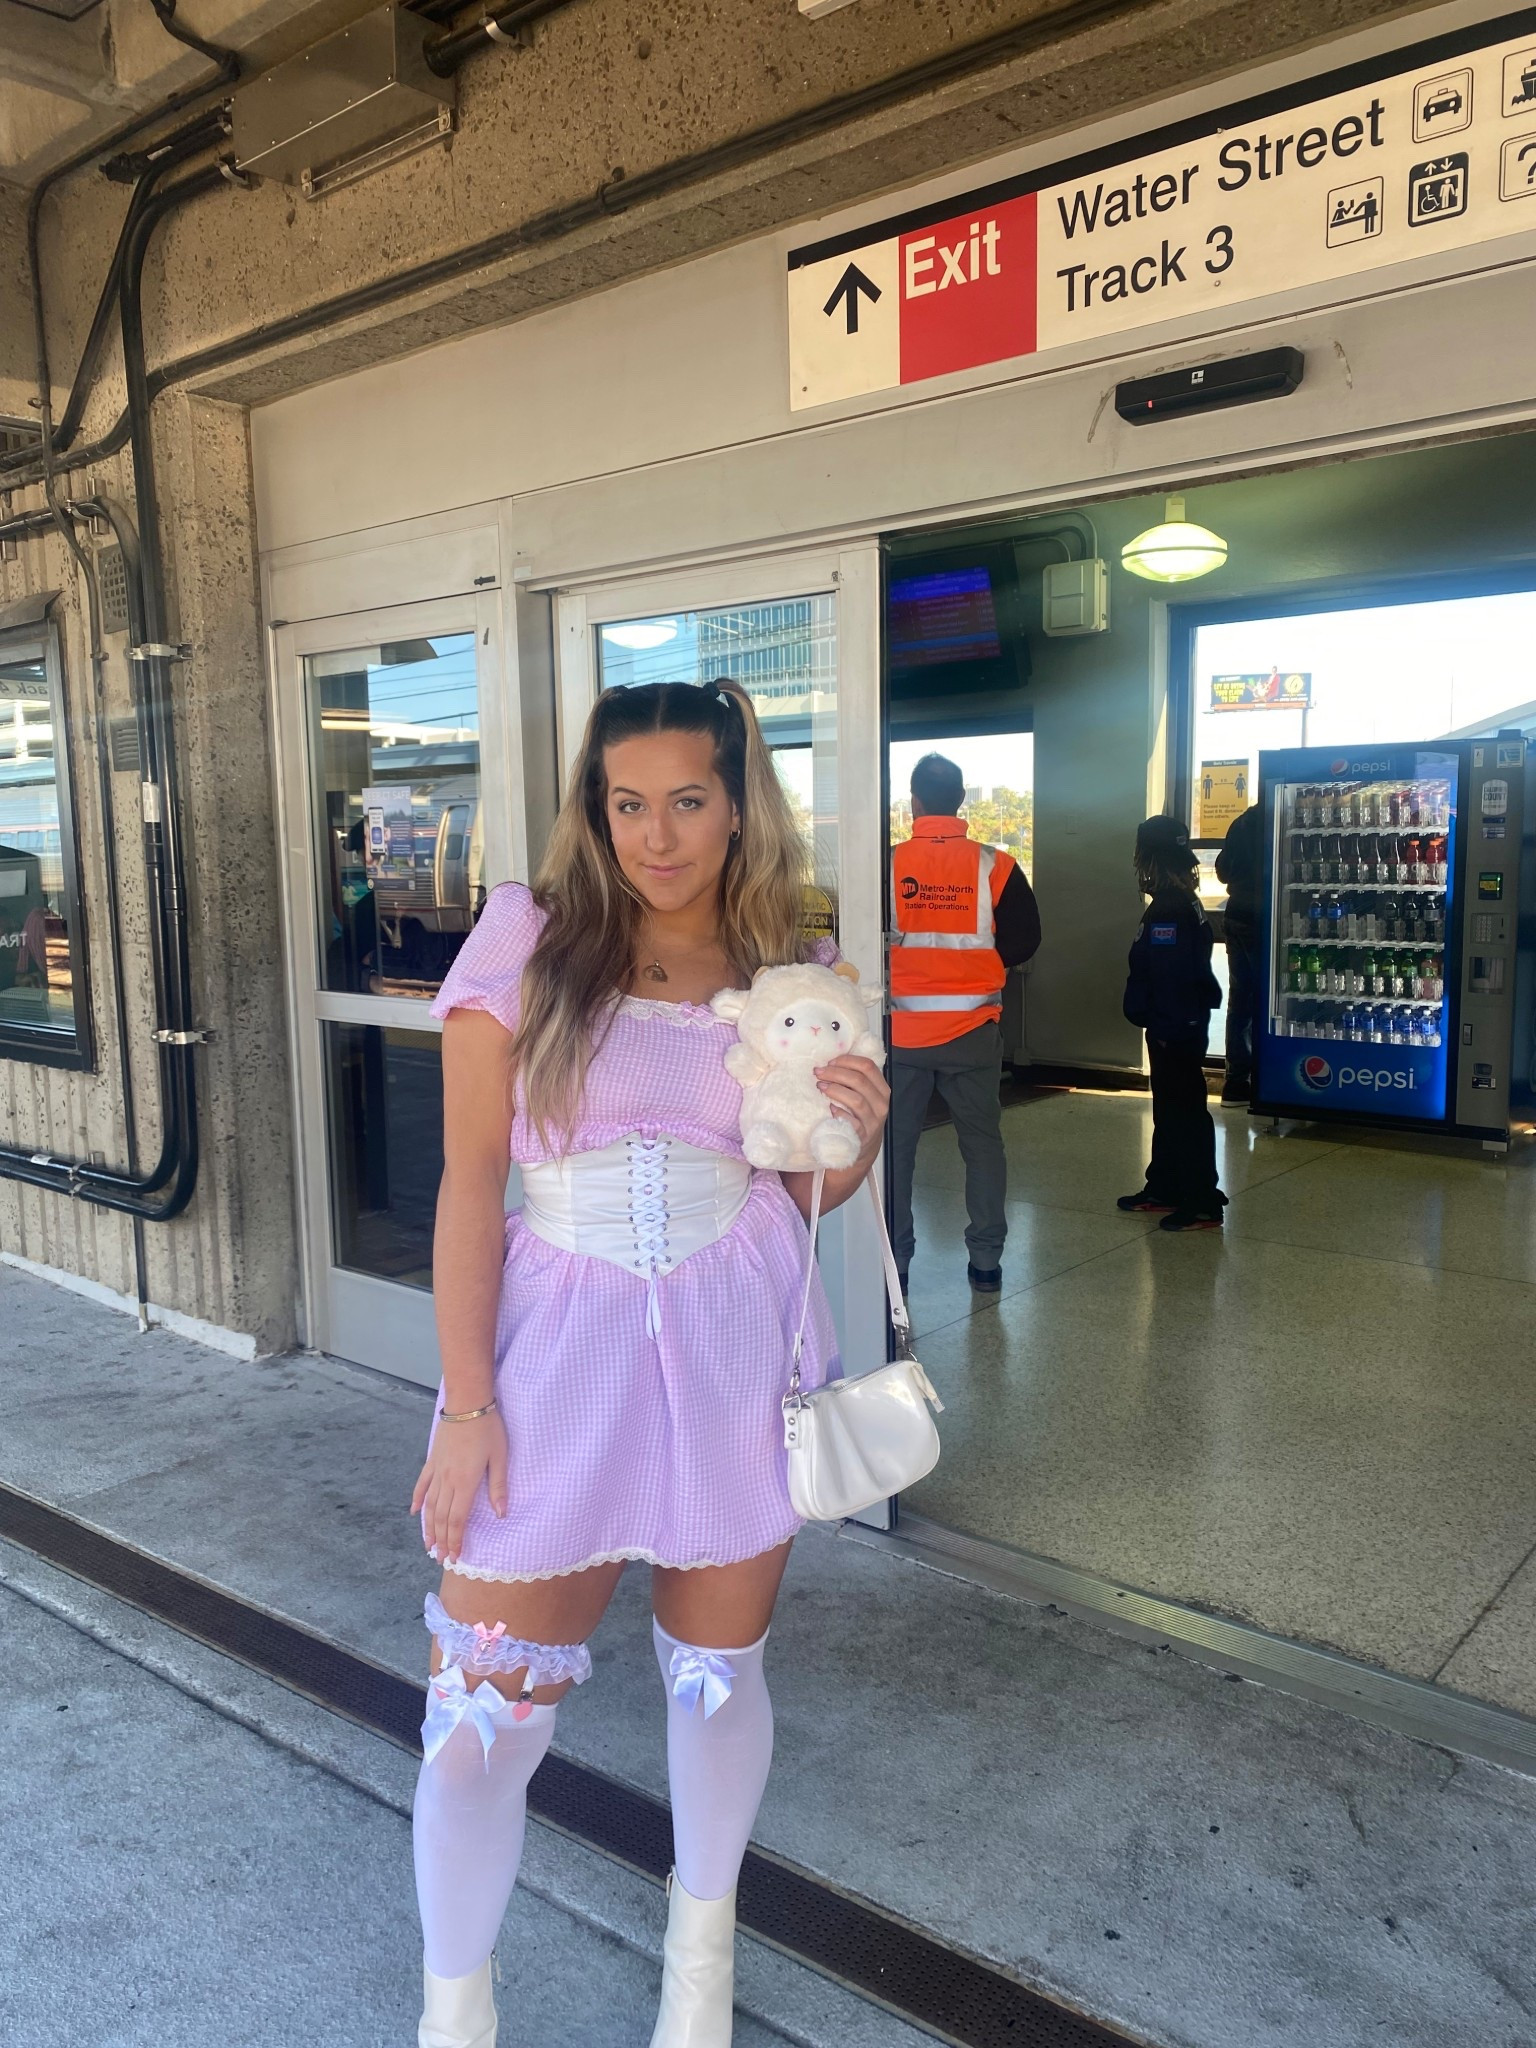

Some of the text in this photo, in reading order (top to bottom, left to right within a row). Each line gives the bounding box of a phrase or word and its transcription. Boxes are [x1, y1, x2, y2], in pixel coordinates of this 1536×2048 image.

[1057, 98, 1385, 239] Water Street
[905, 220, 1001, 300] Exit
[1057, 225, 1235, 312] Track 3
[1351, 760, 1390, 774] pepsi
[920, 884, 974, 894] Metro-North
[920, 893, 957, 902] Railroad
[904, 902, 969, 911] Station Operations
[1338, 1067, 1415, 1092] pepsi
